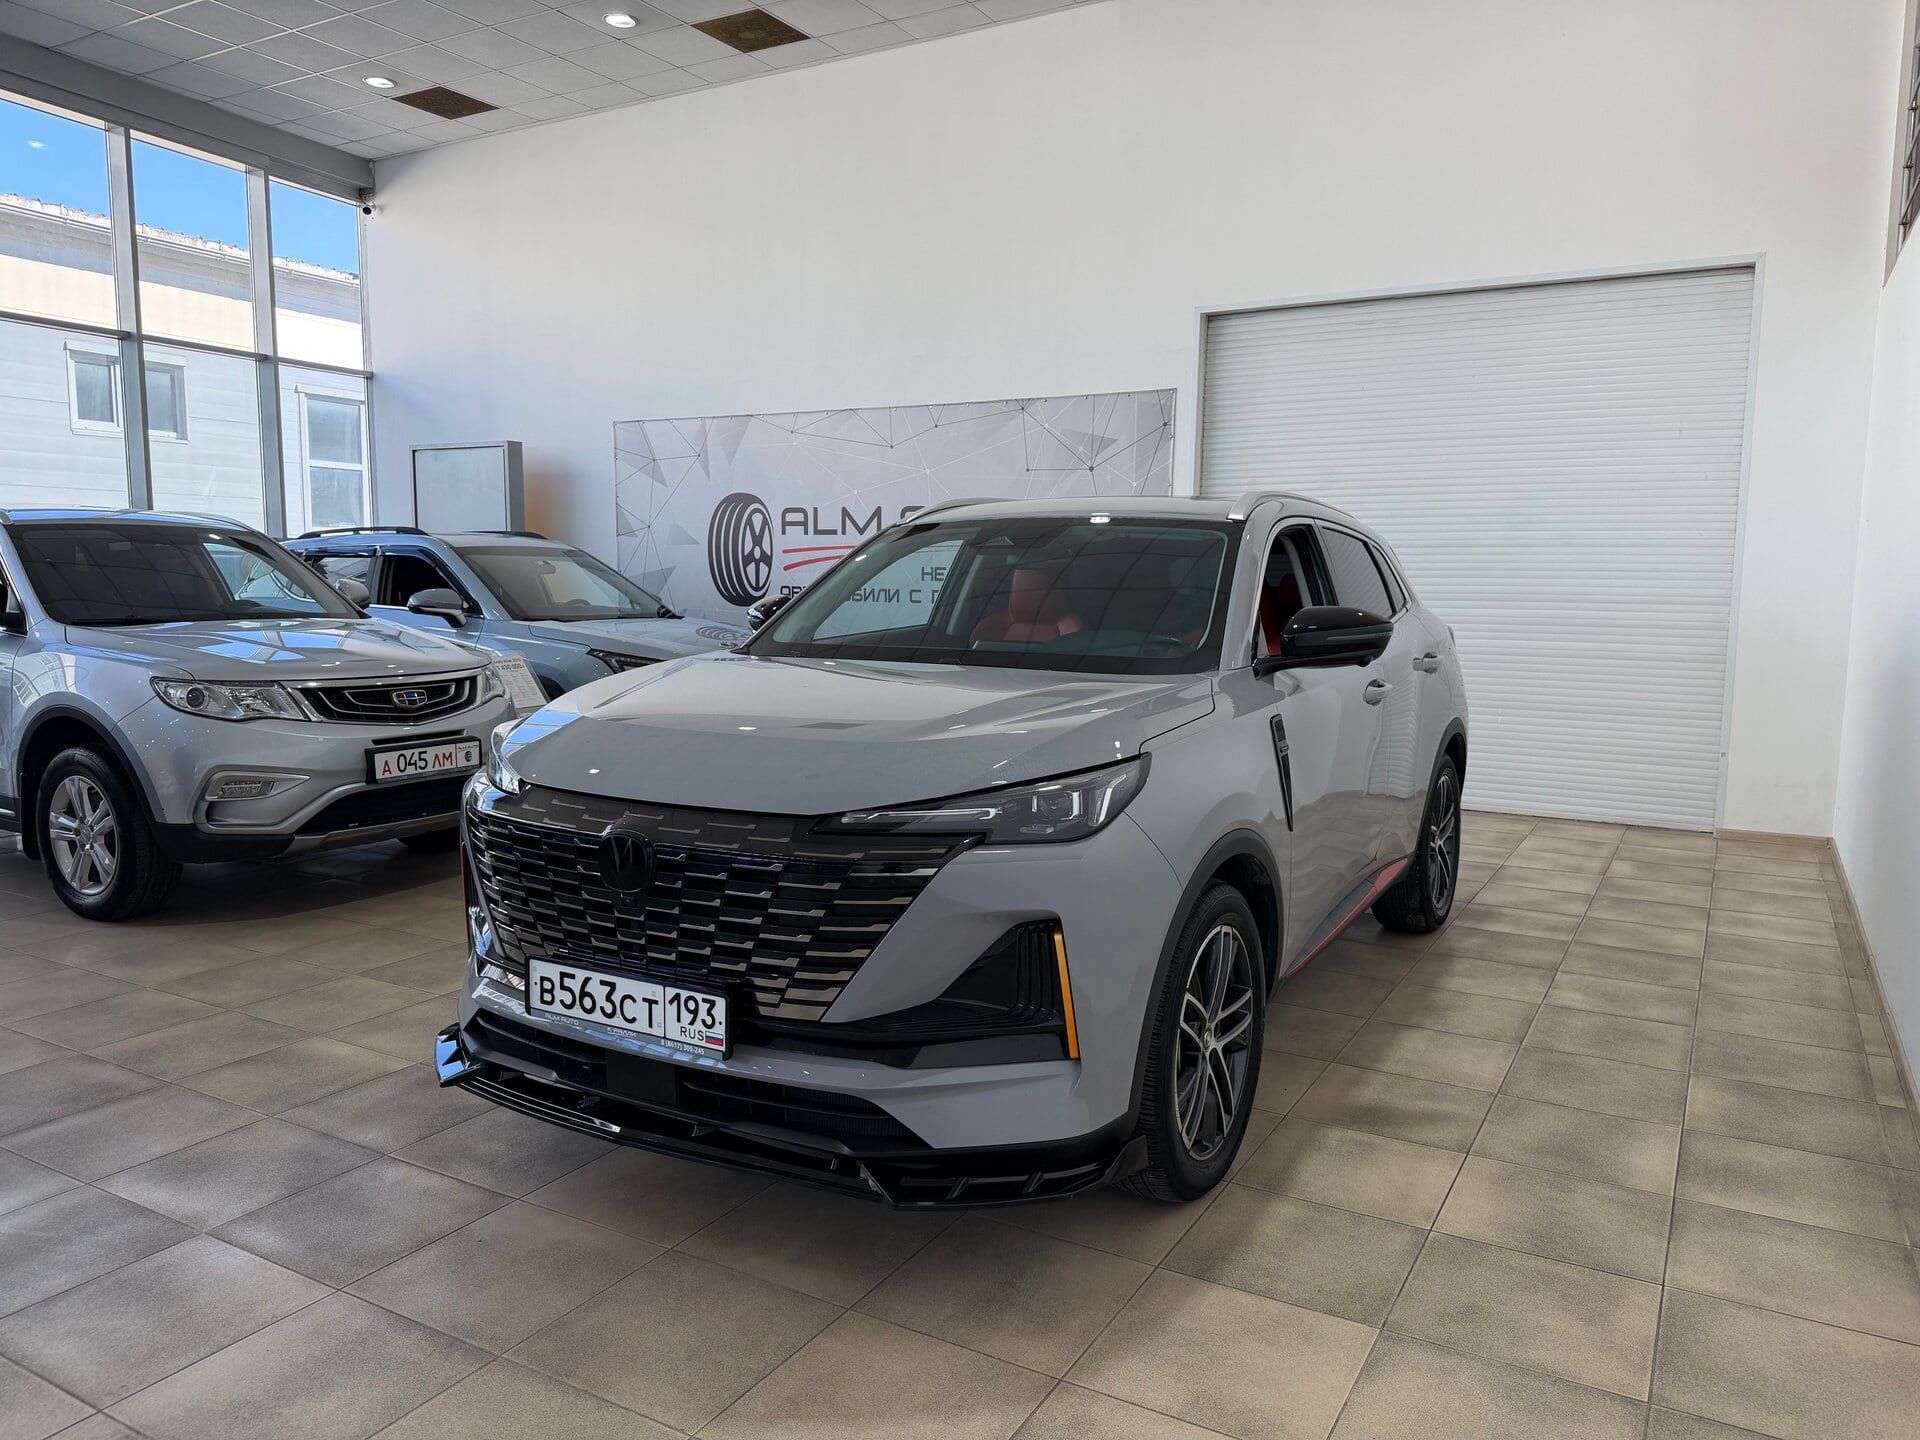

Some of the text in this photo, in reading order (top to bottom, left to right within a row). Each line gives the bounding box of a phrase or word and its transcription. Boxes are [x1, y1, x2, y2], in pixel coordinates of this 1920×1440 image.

[781, 506, 882, 536] ALM
[382, 760, 392, 775] А
[397, 751, 428, 773] 045
[668, 992, 716, 1030] 193
[680, 1026, 705, 1042] RUS
